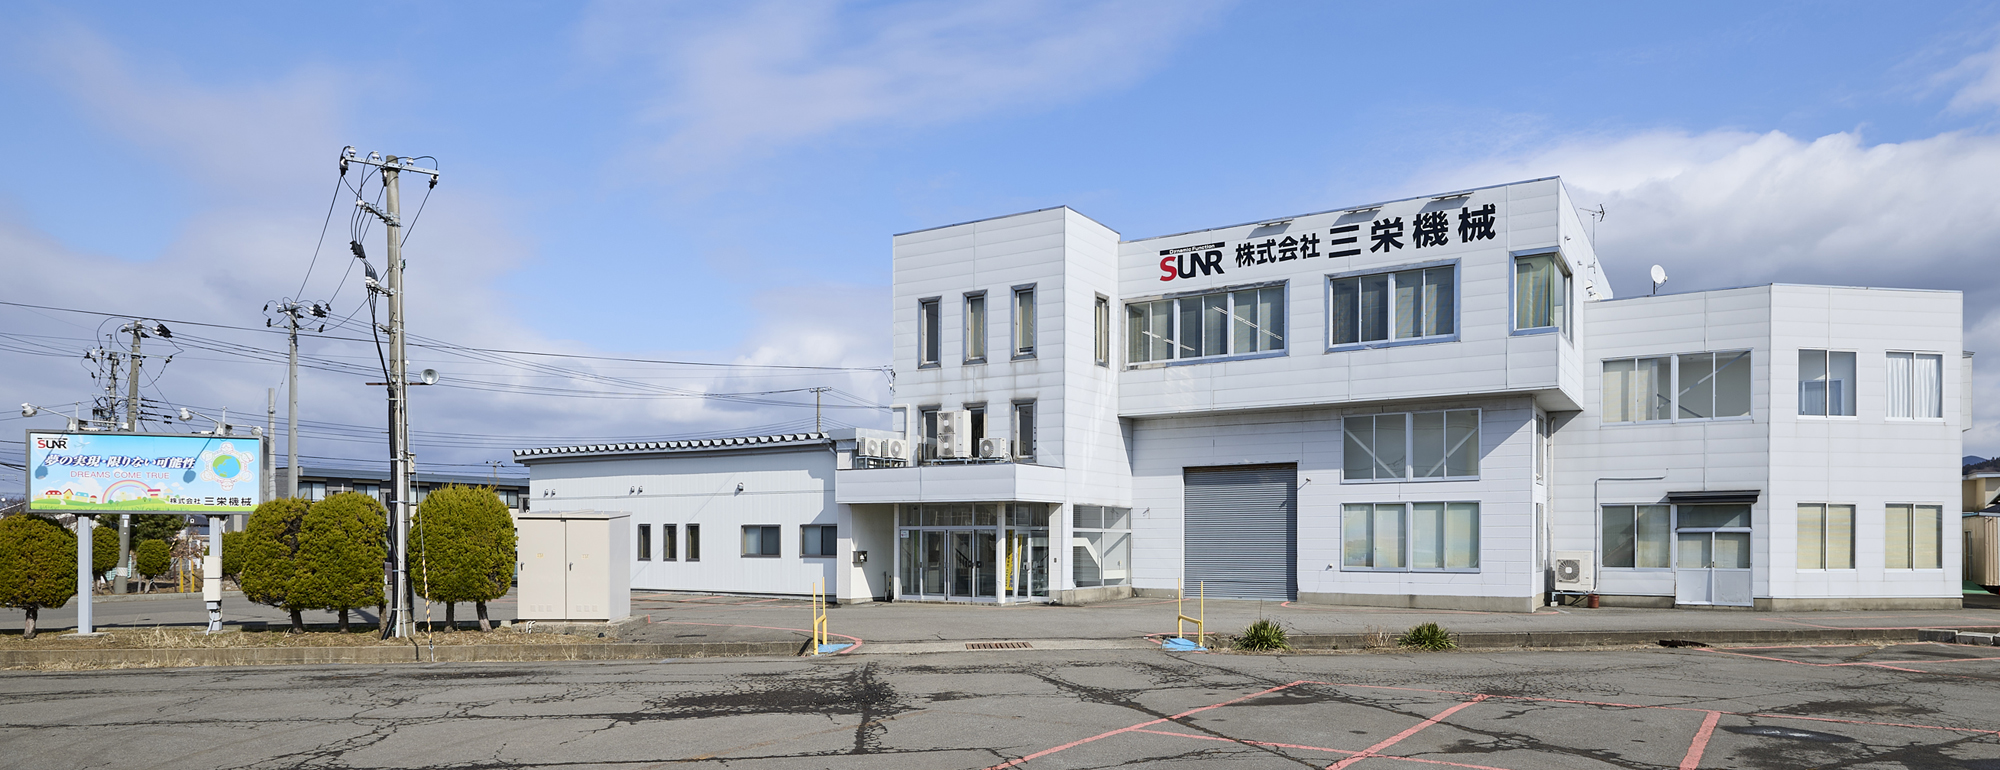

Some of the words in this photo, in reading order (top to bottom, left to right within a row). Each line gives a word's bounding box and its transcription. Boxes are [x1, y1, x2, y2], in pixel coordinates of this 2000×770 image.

[1235, 232, 1321, 268] 株式会社
[1328, 203, 1497, 259] 三栄機械
[1160, 250, 1226, 282] SUNR
[37, 439, 67, 450] SUNR
[70, 470, 111, 479] DREAMS
[113, 471, 142, 479] COME
[145, 471, 170, 480] TRUE
[169, 497, 201, 505] 株式会社
[204, 496, 252, 507] 三栄機械
